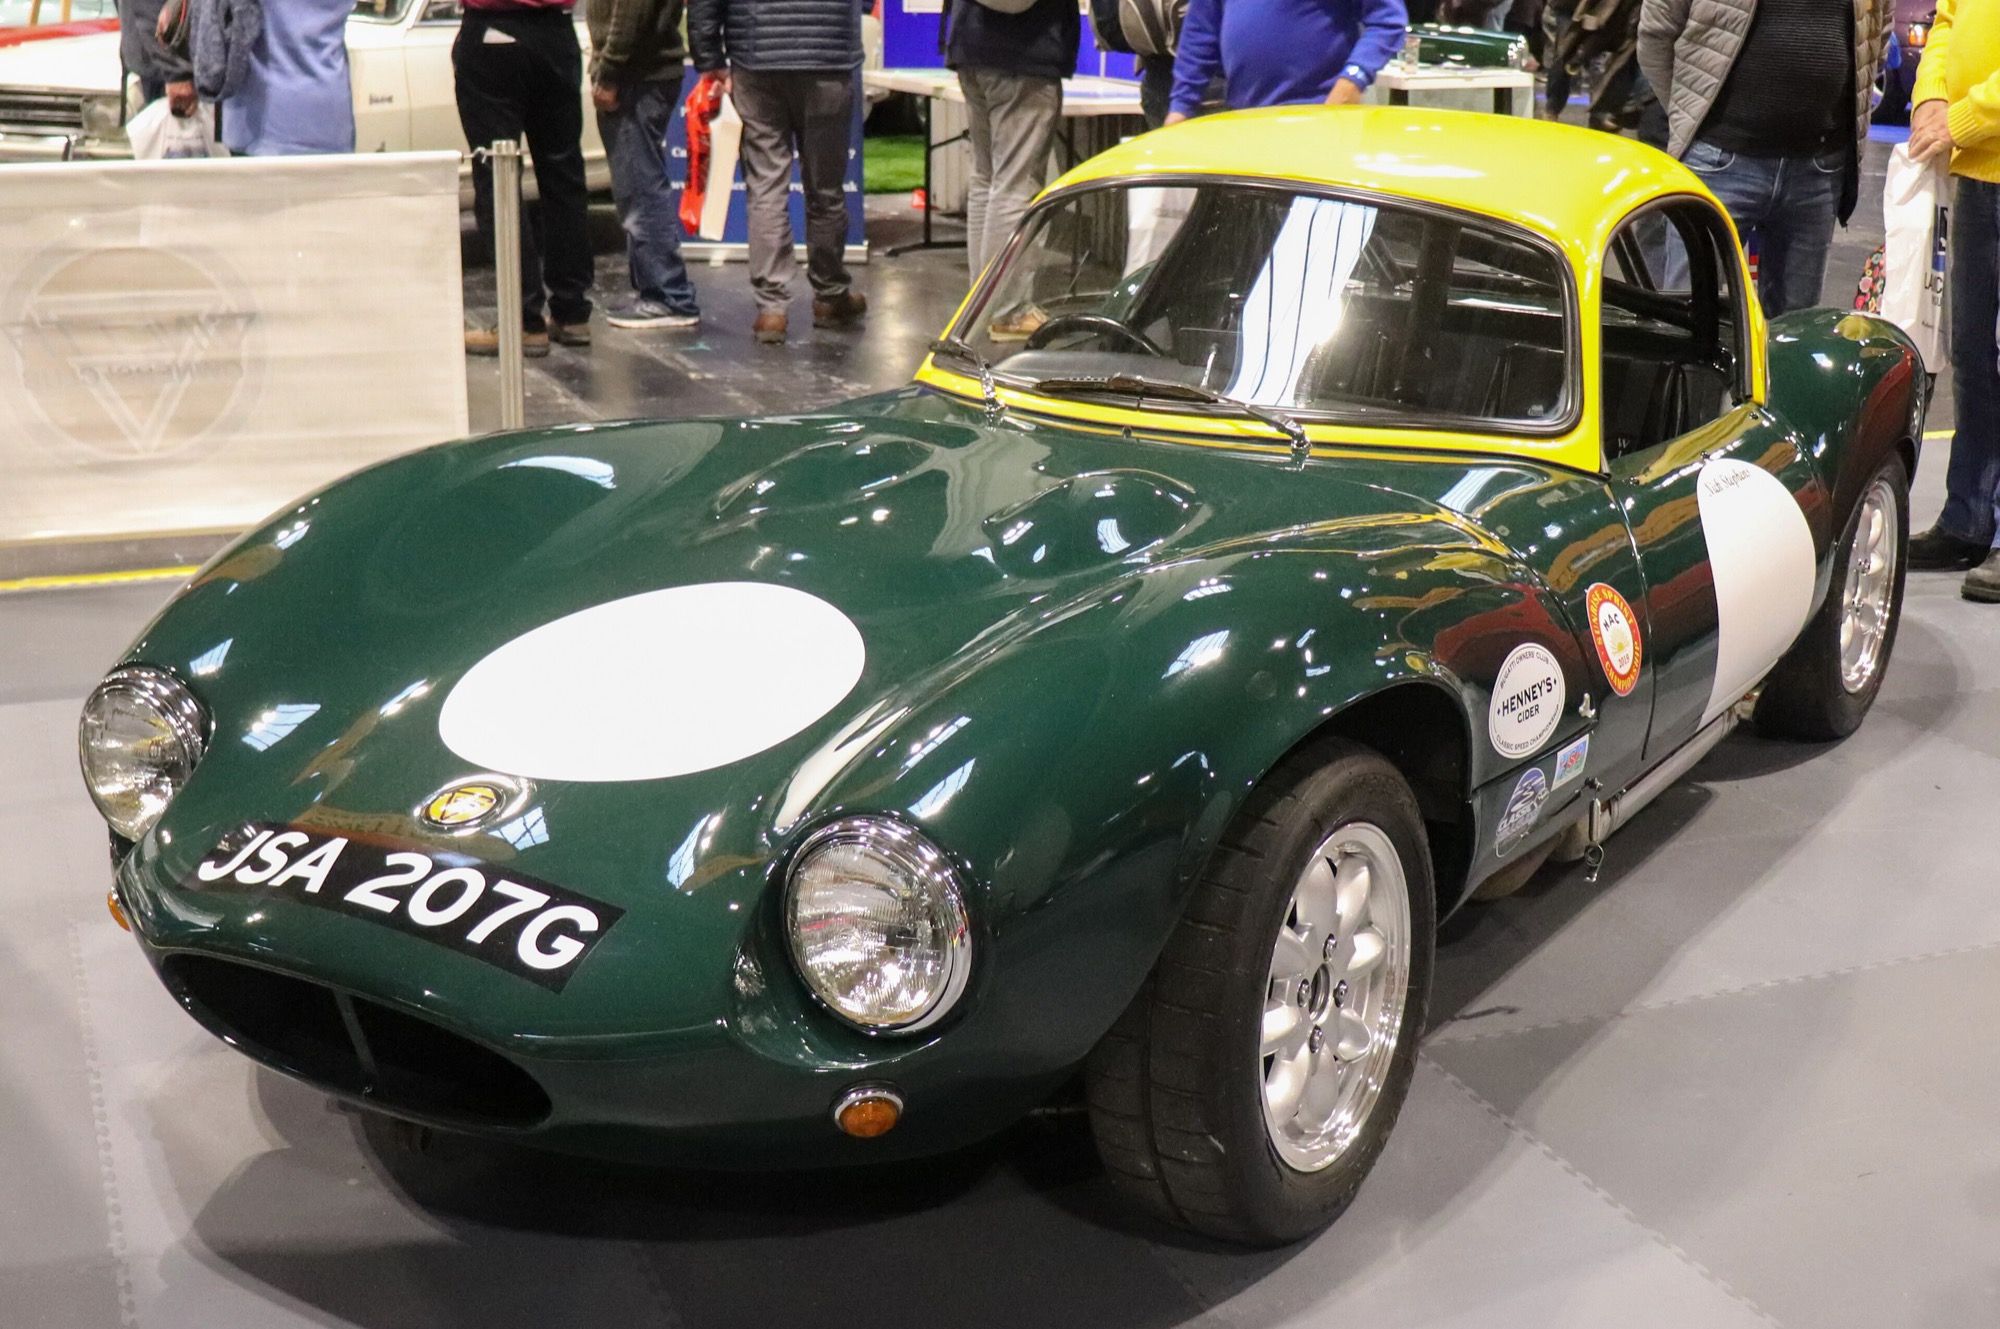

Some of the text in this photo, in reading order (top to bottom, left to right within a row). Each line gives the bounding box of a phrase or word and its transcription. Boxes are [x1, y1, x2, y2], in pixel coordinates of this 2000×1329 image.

[1602, 589, 1633, 624] SPRINT
[1536, 651, 1549, 665] CLUB
[1605, 641, 1640, 691] CHAMPIONSHIP
[1502, 677, 1553, 717] HENNEY'S
[1517, 703, 1540, 723] CIDER
[1496, 703, 1559, 750] CLASSIC SPEED CHAMPIONSHIP
[197, 830, 600, 970] JSA 207G
